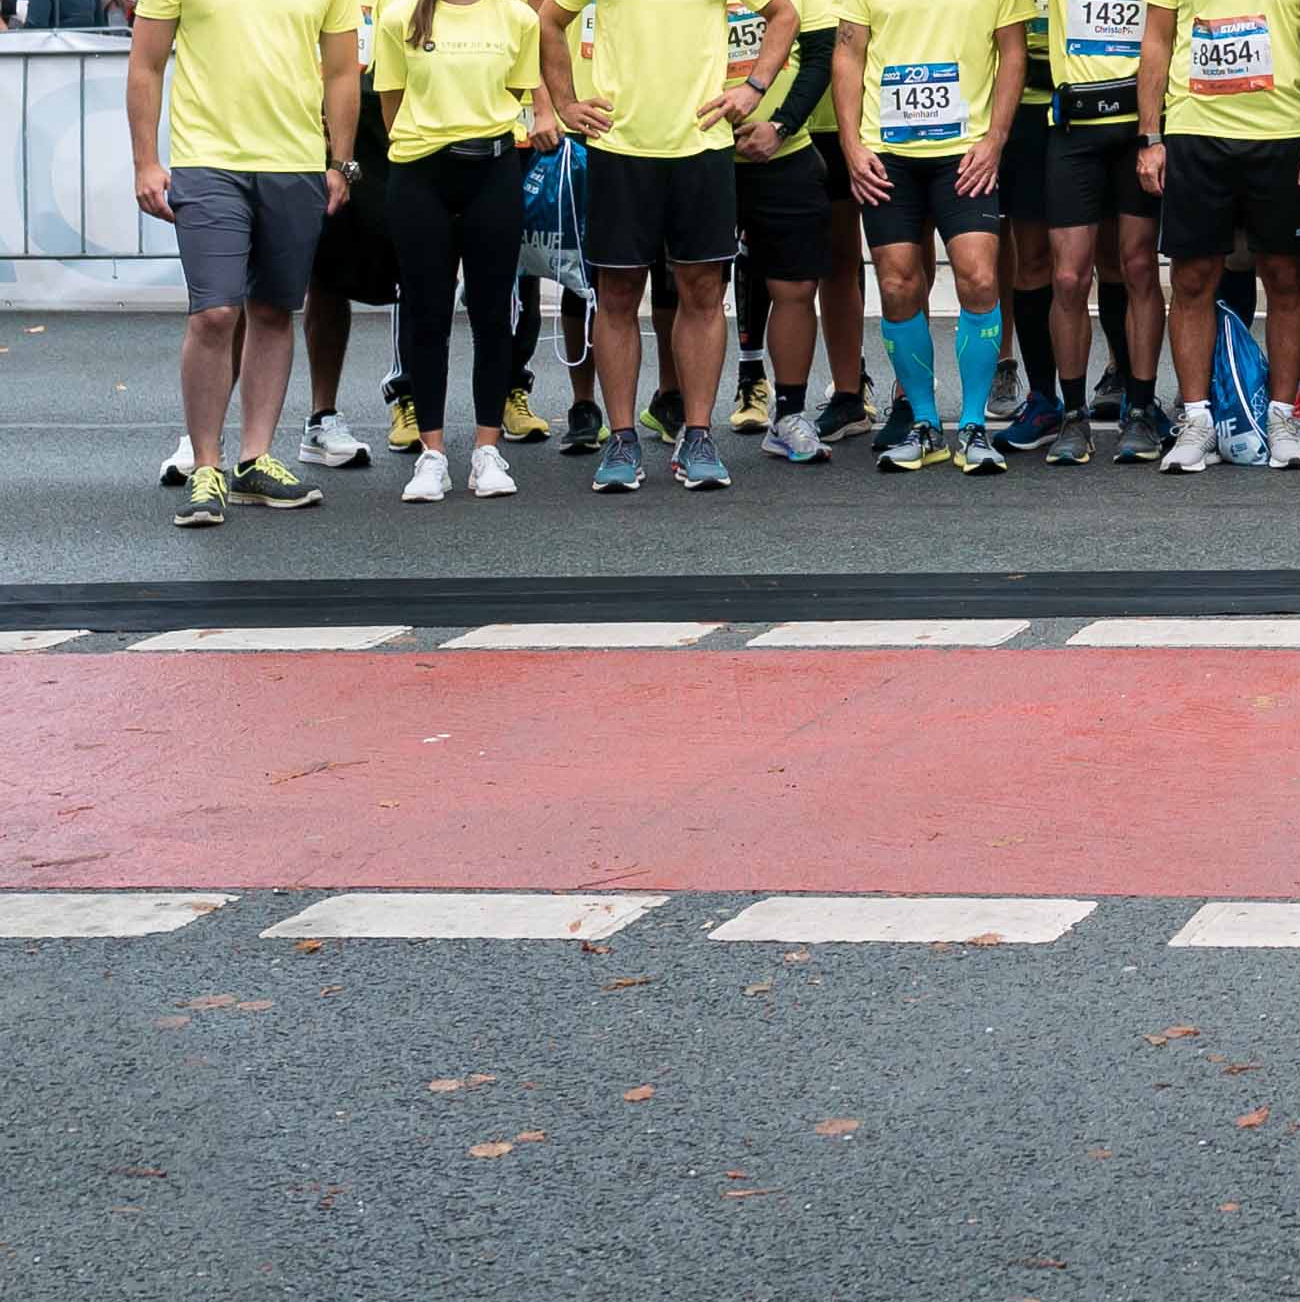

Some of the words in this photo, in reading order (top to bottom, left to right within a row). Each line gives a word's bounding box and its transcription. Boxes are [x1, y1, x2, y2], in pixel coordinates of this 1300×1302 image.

[1083, 2, 1139, 27] 1432
[1220, 23, 1256, 33] STAFFEL
[1199, 41, 1252, 66] 8454
[892, 86, 950, 111] 1433
